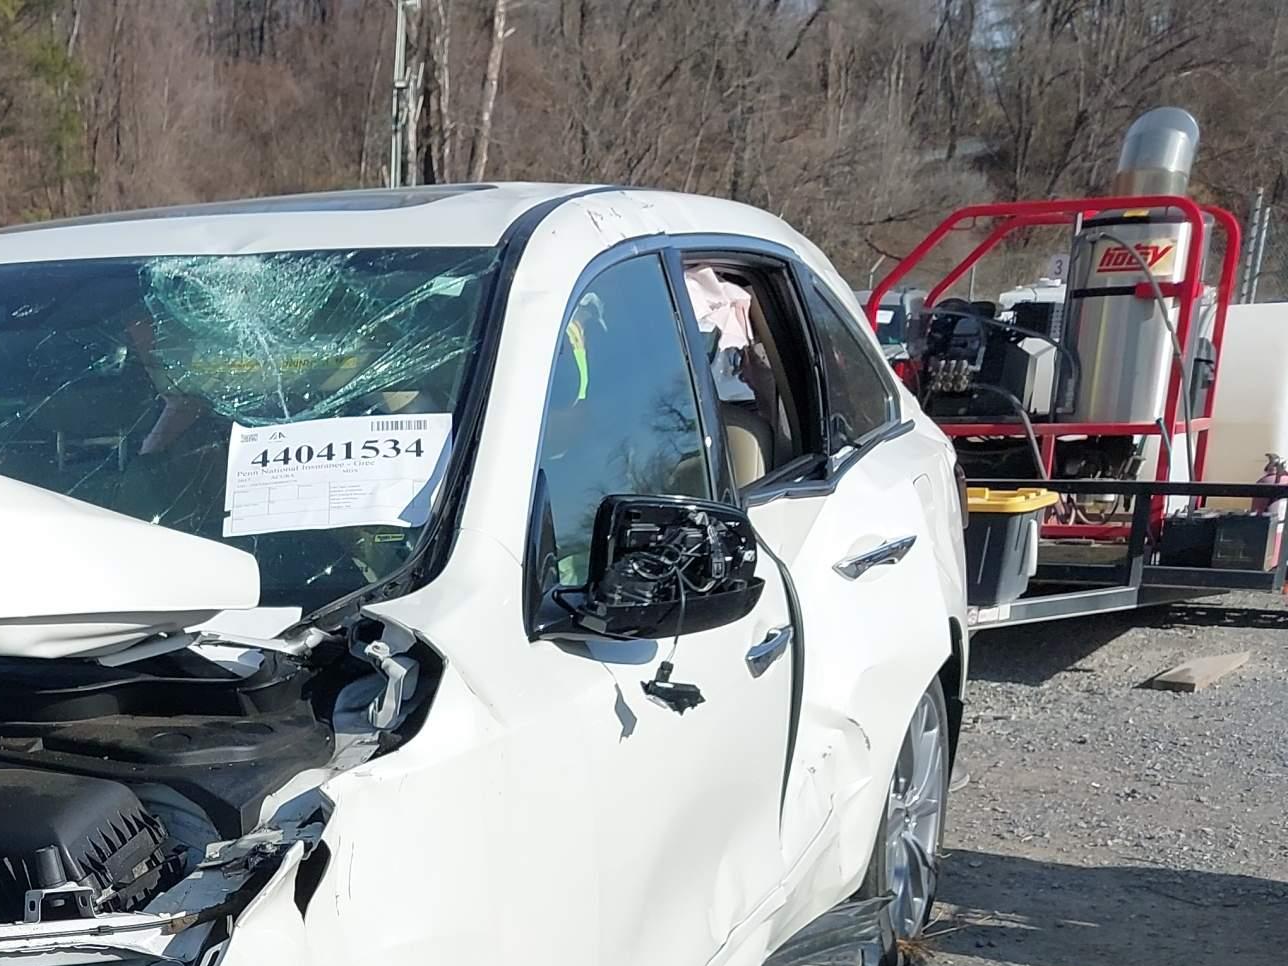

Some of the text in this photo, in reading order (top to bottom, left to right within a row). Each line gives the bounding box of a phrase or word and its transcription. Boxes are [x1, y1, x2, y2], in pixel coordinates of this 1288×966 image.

[250, 438, 425, 468] 44041534
[236, 470, 259, 478] Penn
[261, 465, 299, 476] National
[302, 462, 344, 471] Insurance
